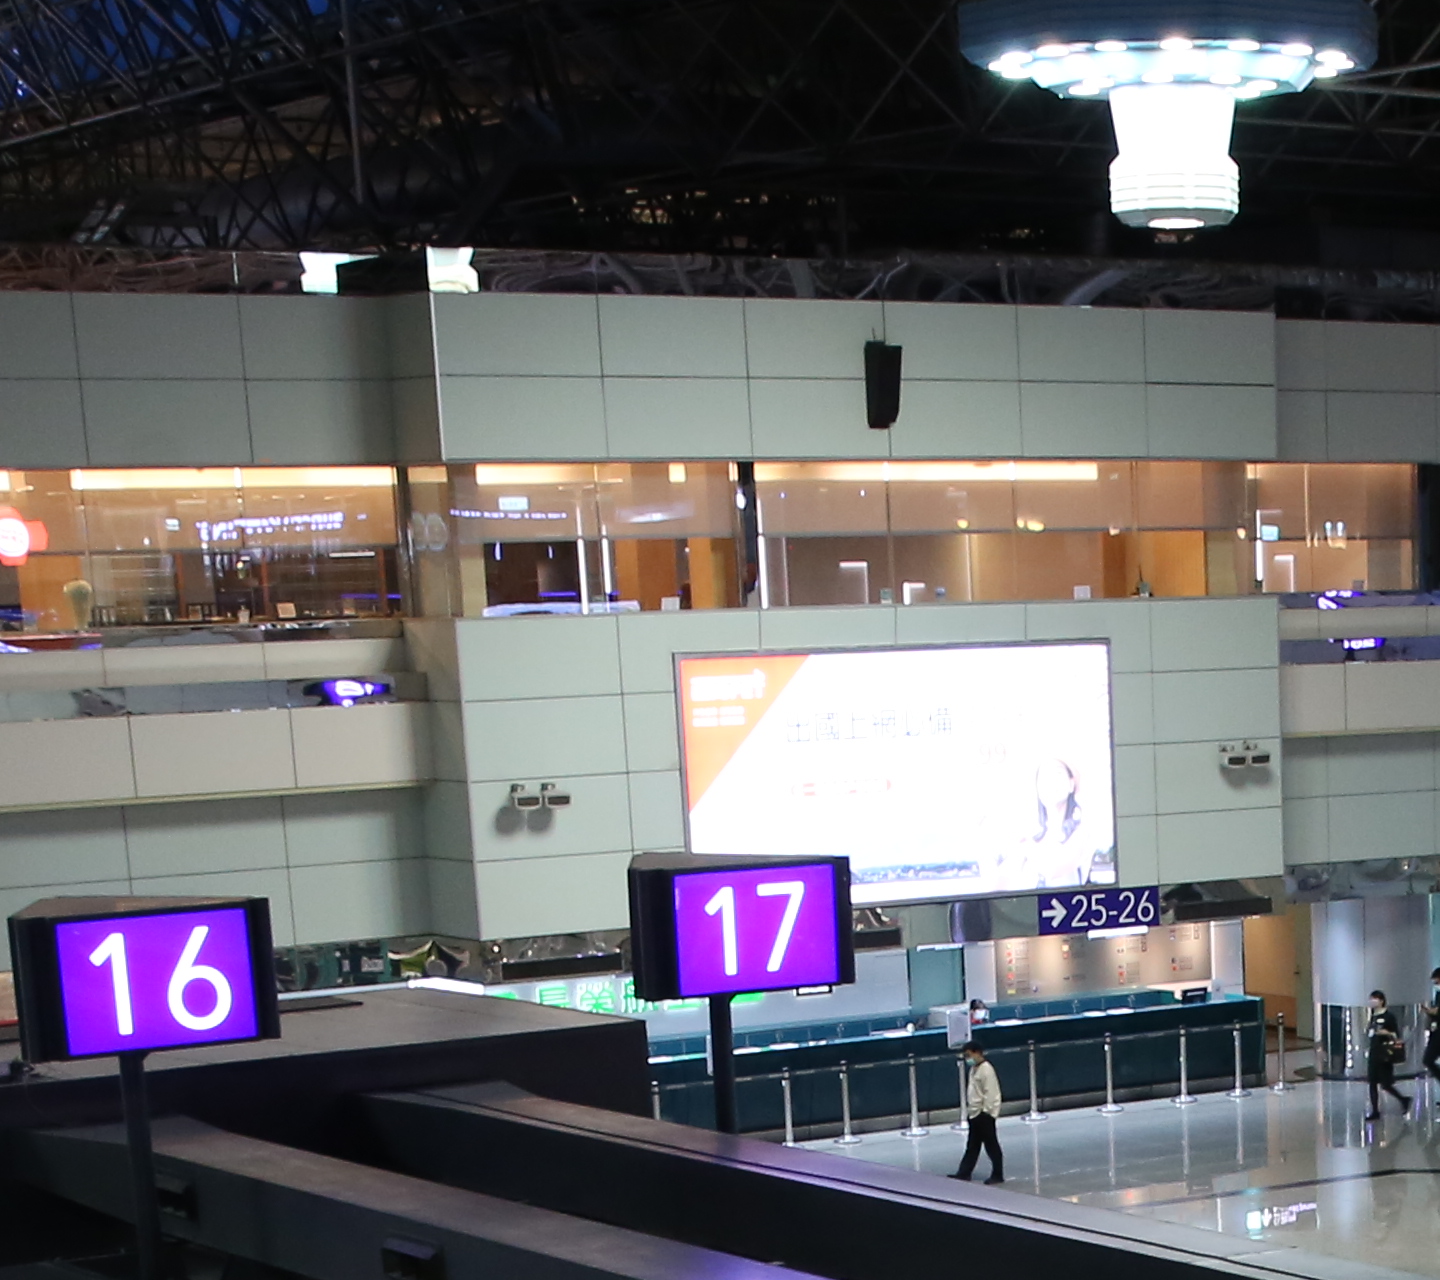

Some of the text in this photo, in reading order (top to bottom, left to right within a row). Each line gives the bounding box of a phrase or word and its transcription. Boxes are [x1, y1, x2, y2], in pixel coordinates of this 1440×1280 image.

[704, 880, 807, 978] 17
[1071, 888, 1155, 927] 25-26
[88, 924, 234, 1038] 16
